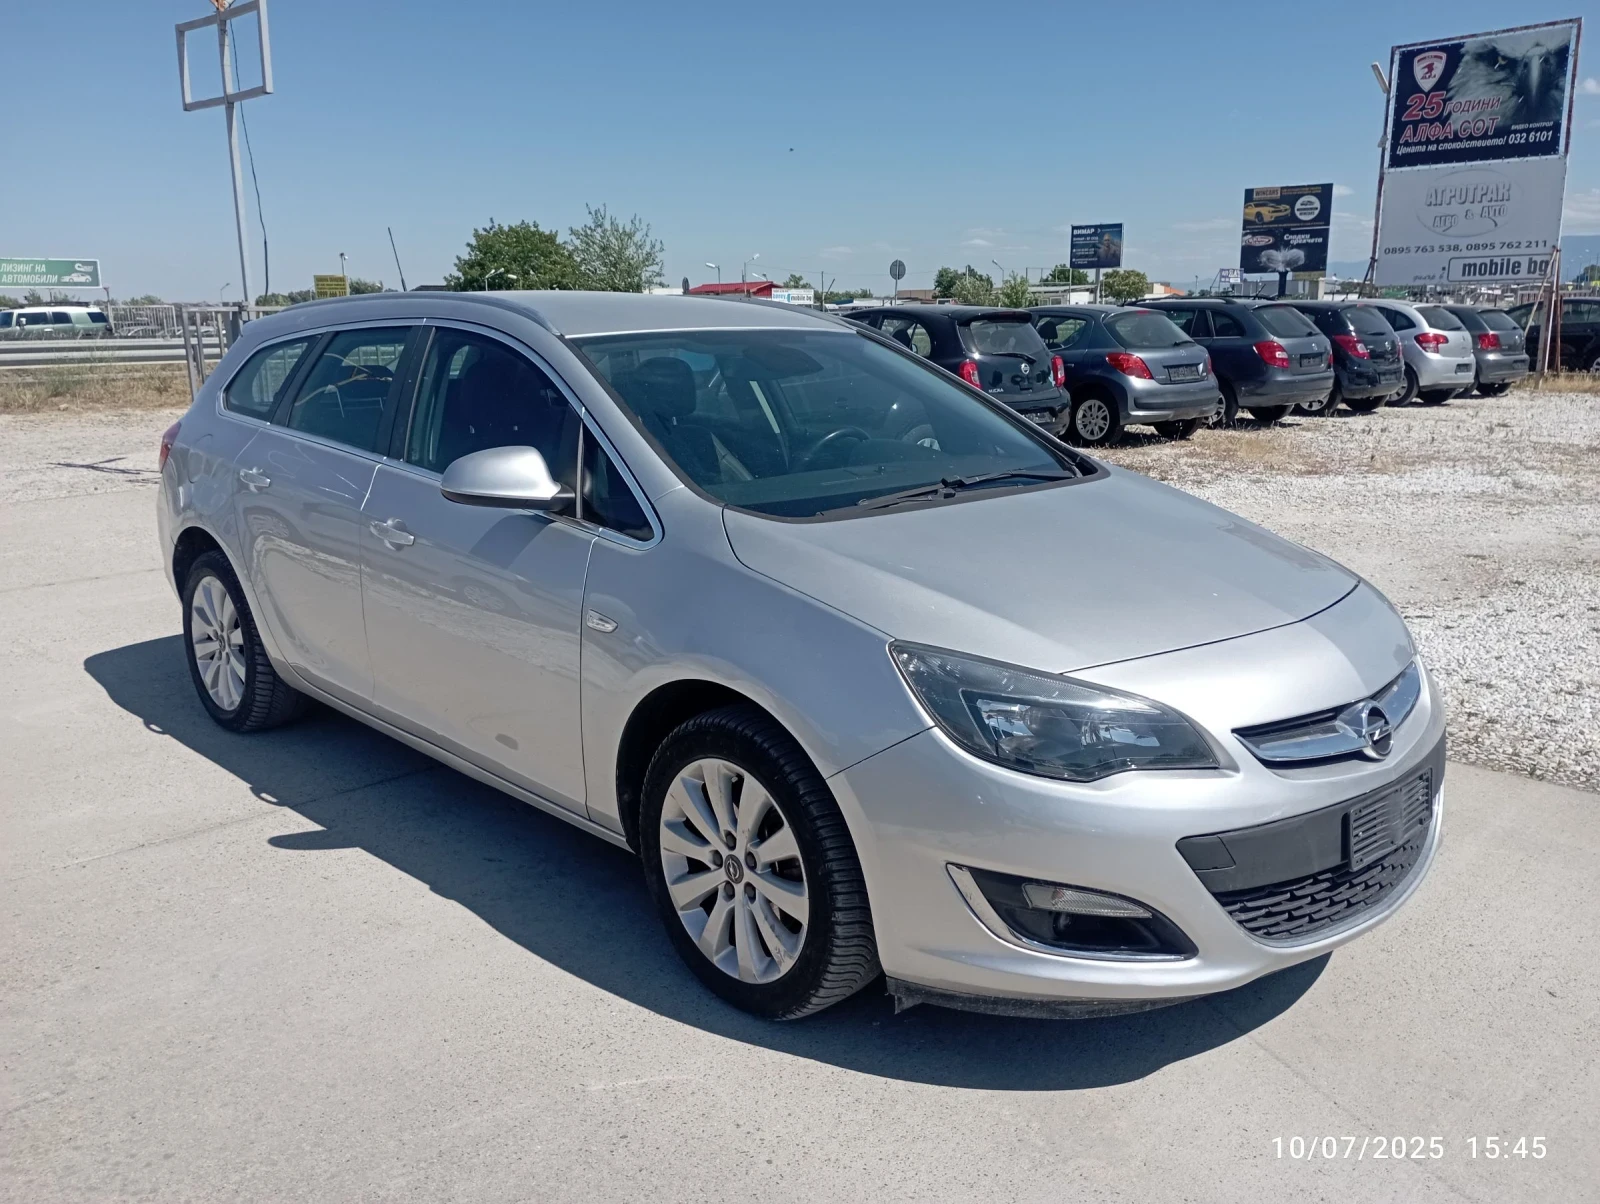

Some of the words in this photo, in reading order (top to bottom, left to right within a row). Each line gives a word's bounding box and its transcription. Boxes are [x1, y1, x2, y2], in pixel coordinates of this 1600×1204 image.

[1402, 91, 1447, 121] 25
[1444, 97, 1501, 115] ГОДИНИ
[1399, 122, 1453, 144] АЛФА
[1458, 116, 1500, 138] СОТ
[1397, 145, 1426, 156] Цената
[1427, 144, 1437, 152] на
[1438, 135, 1507, 151] спокойствието!
[1508, 132, 1527, 144] 032
[1528, 130, 1553, 142] 6101
[1425, 182, 1511, 207] АГРОТРАК
[1384, 246, 1411, 255] 0895
[1414, 245, 1435, 253] 763
[1437, 243, 1463, 253] 538,
[1466, 242, 1496, 251] 0895
[1499, 241, 1522, 250] 762
[1525, 240, 1547, 249] 211
[0, 263, 34, 273] ЛИЗИНГ
[35, 263, 46, 273] НА
[1462, 258, 1522, 277] mobile
[1527, 257, 1550, 276] bg
[2, 274, 58, 284] АВТОМОБИЛИ
